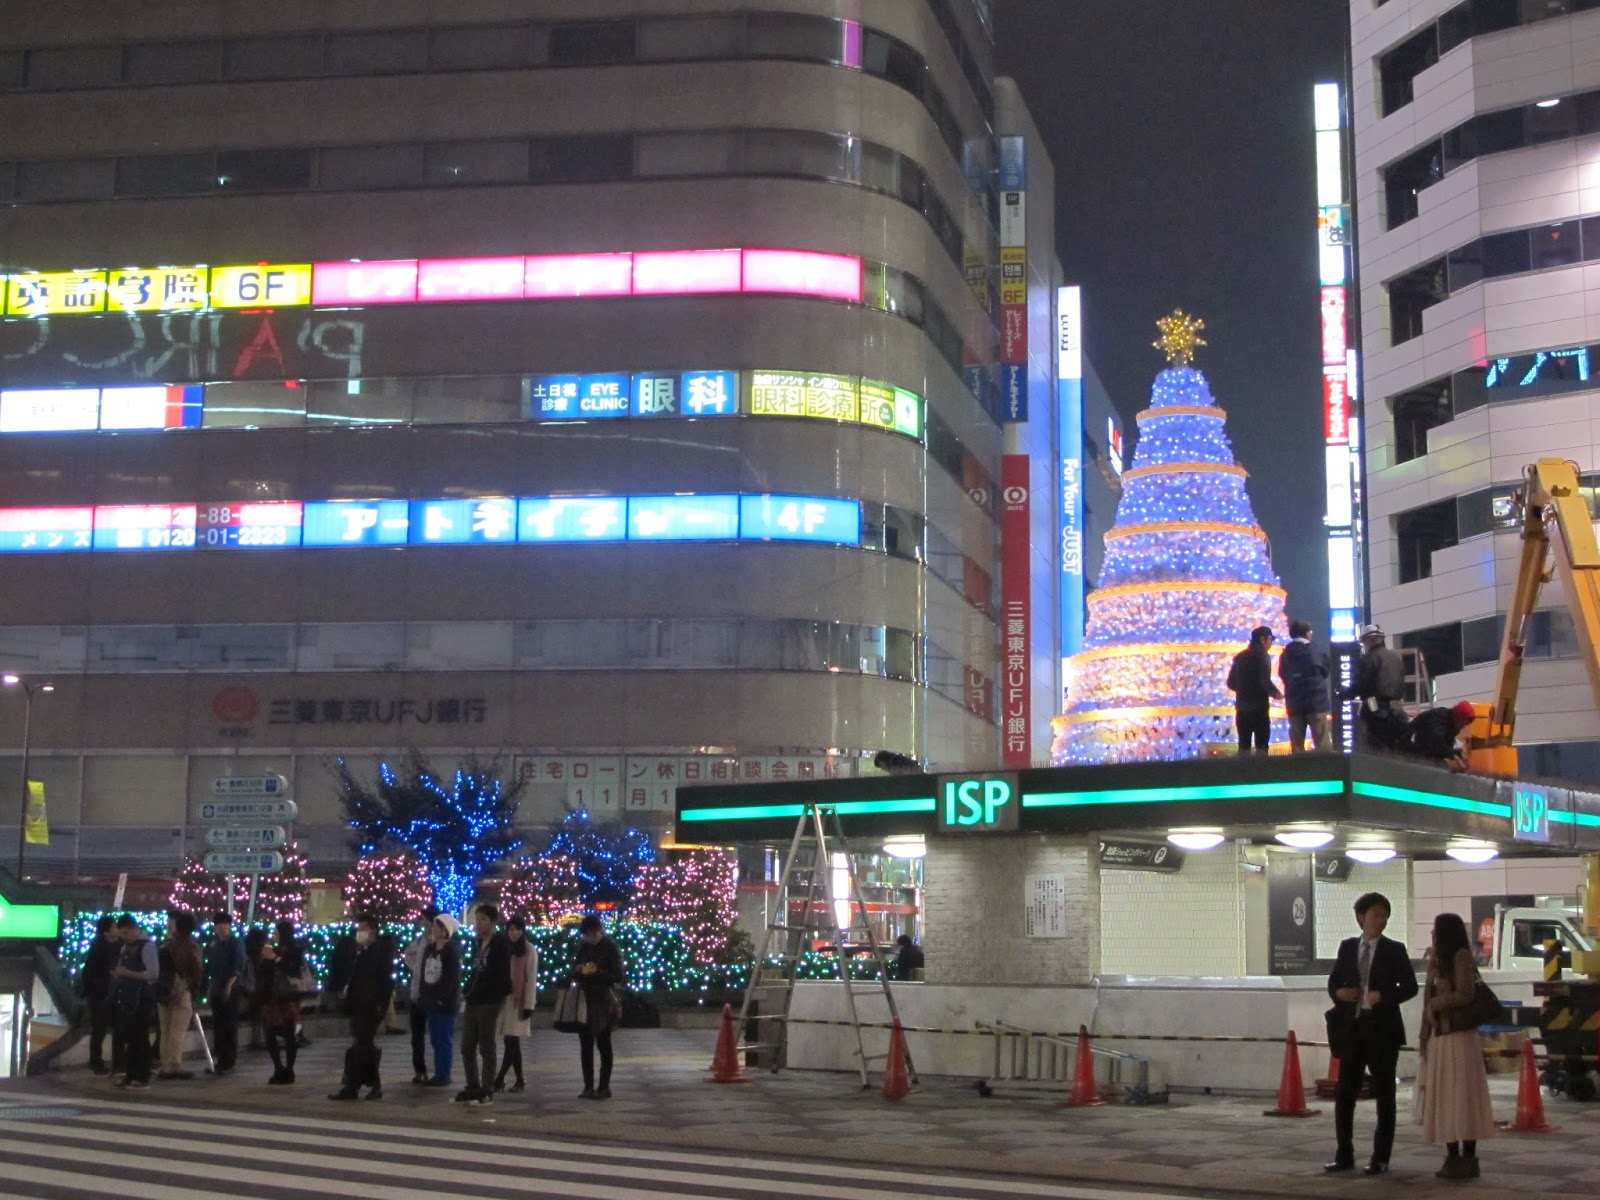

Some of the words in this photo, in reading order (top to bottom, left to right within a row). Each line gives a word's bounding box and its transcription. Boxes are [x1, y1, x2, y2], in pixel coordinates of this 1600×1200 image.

[238, 272, 286, 301] 6F
[1003, 289, 1023, 303] 6F
[533, 383, 577, 397] 土日祝
[590, 383, 619, 396] EYE
[638, 375, 727, 414] 眼科
[541, 398, 568, 411] 診療
[580, 397, 628, 411] CLINIC
[753, 387, 878, 424] 眼科診療所
[1063, 458, 1079, 482] For
[777, 503, 826, 533] 4F
[21, 530, 92, 548] メンズ
[149, 527, 286, 546] 0120-01-2323
[1062, 525, 1082, 575] JUST
[1007, 601, 1025, 752] 三菱東京UFJ銀行
[268, 697, 488, 725] 三菱東京UFJ銀行
[944, 779, 1010, 827] ISP
[1516, 791, 1544, 833] ISP
